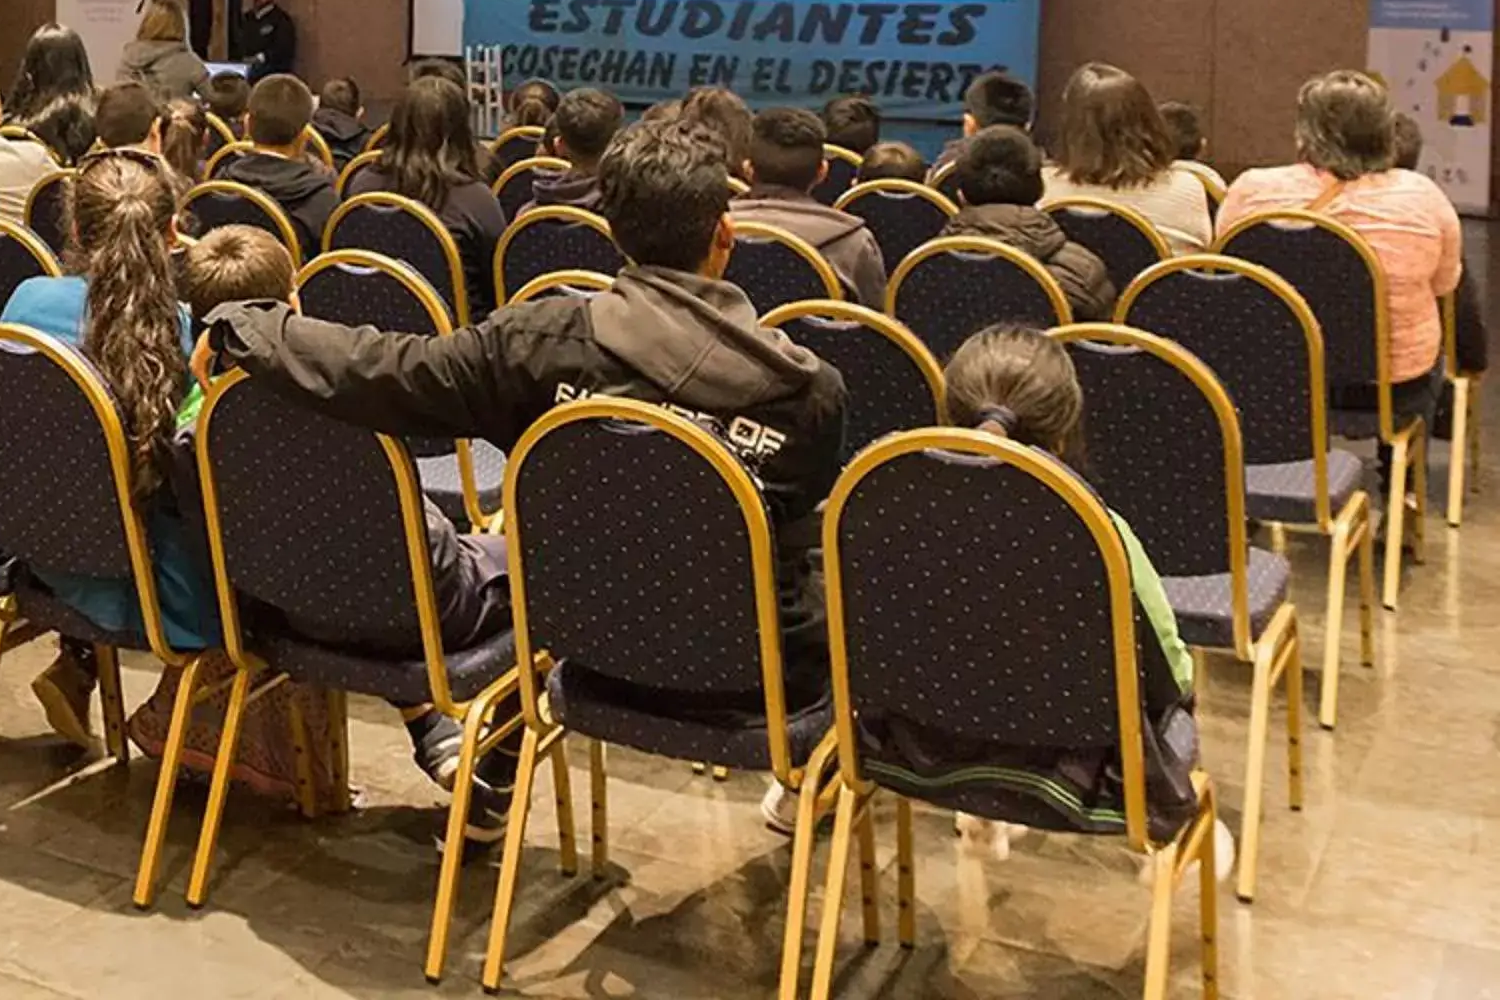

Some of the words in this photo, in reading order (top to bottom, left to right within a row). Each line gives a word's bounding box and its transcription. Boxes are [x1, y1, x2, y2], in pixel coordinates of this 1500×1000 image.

[500, 43, 676, 88] COSECHAN
[688, 53, 740, 88] EN
[754, 57, 792, 94] EL
[729, 415, 788, 454] OF
